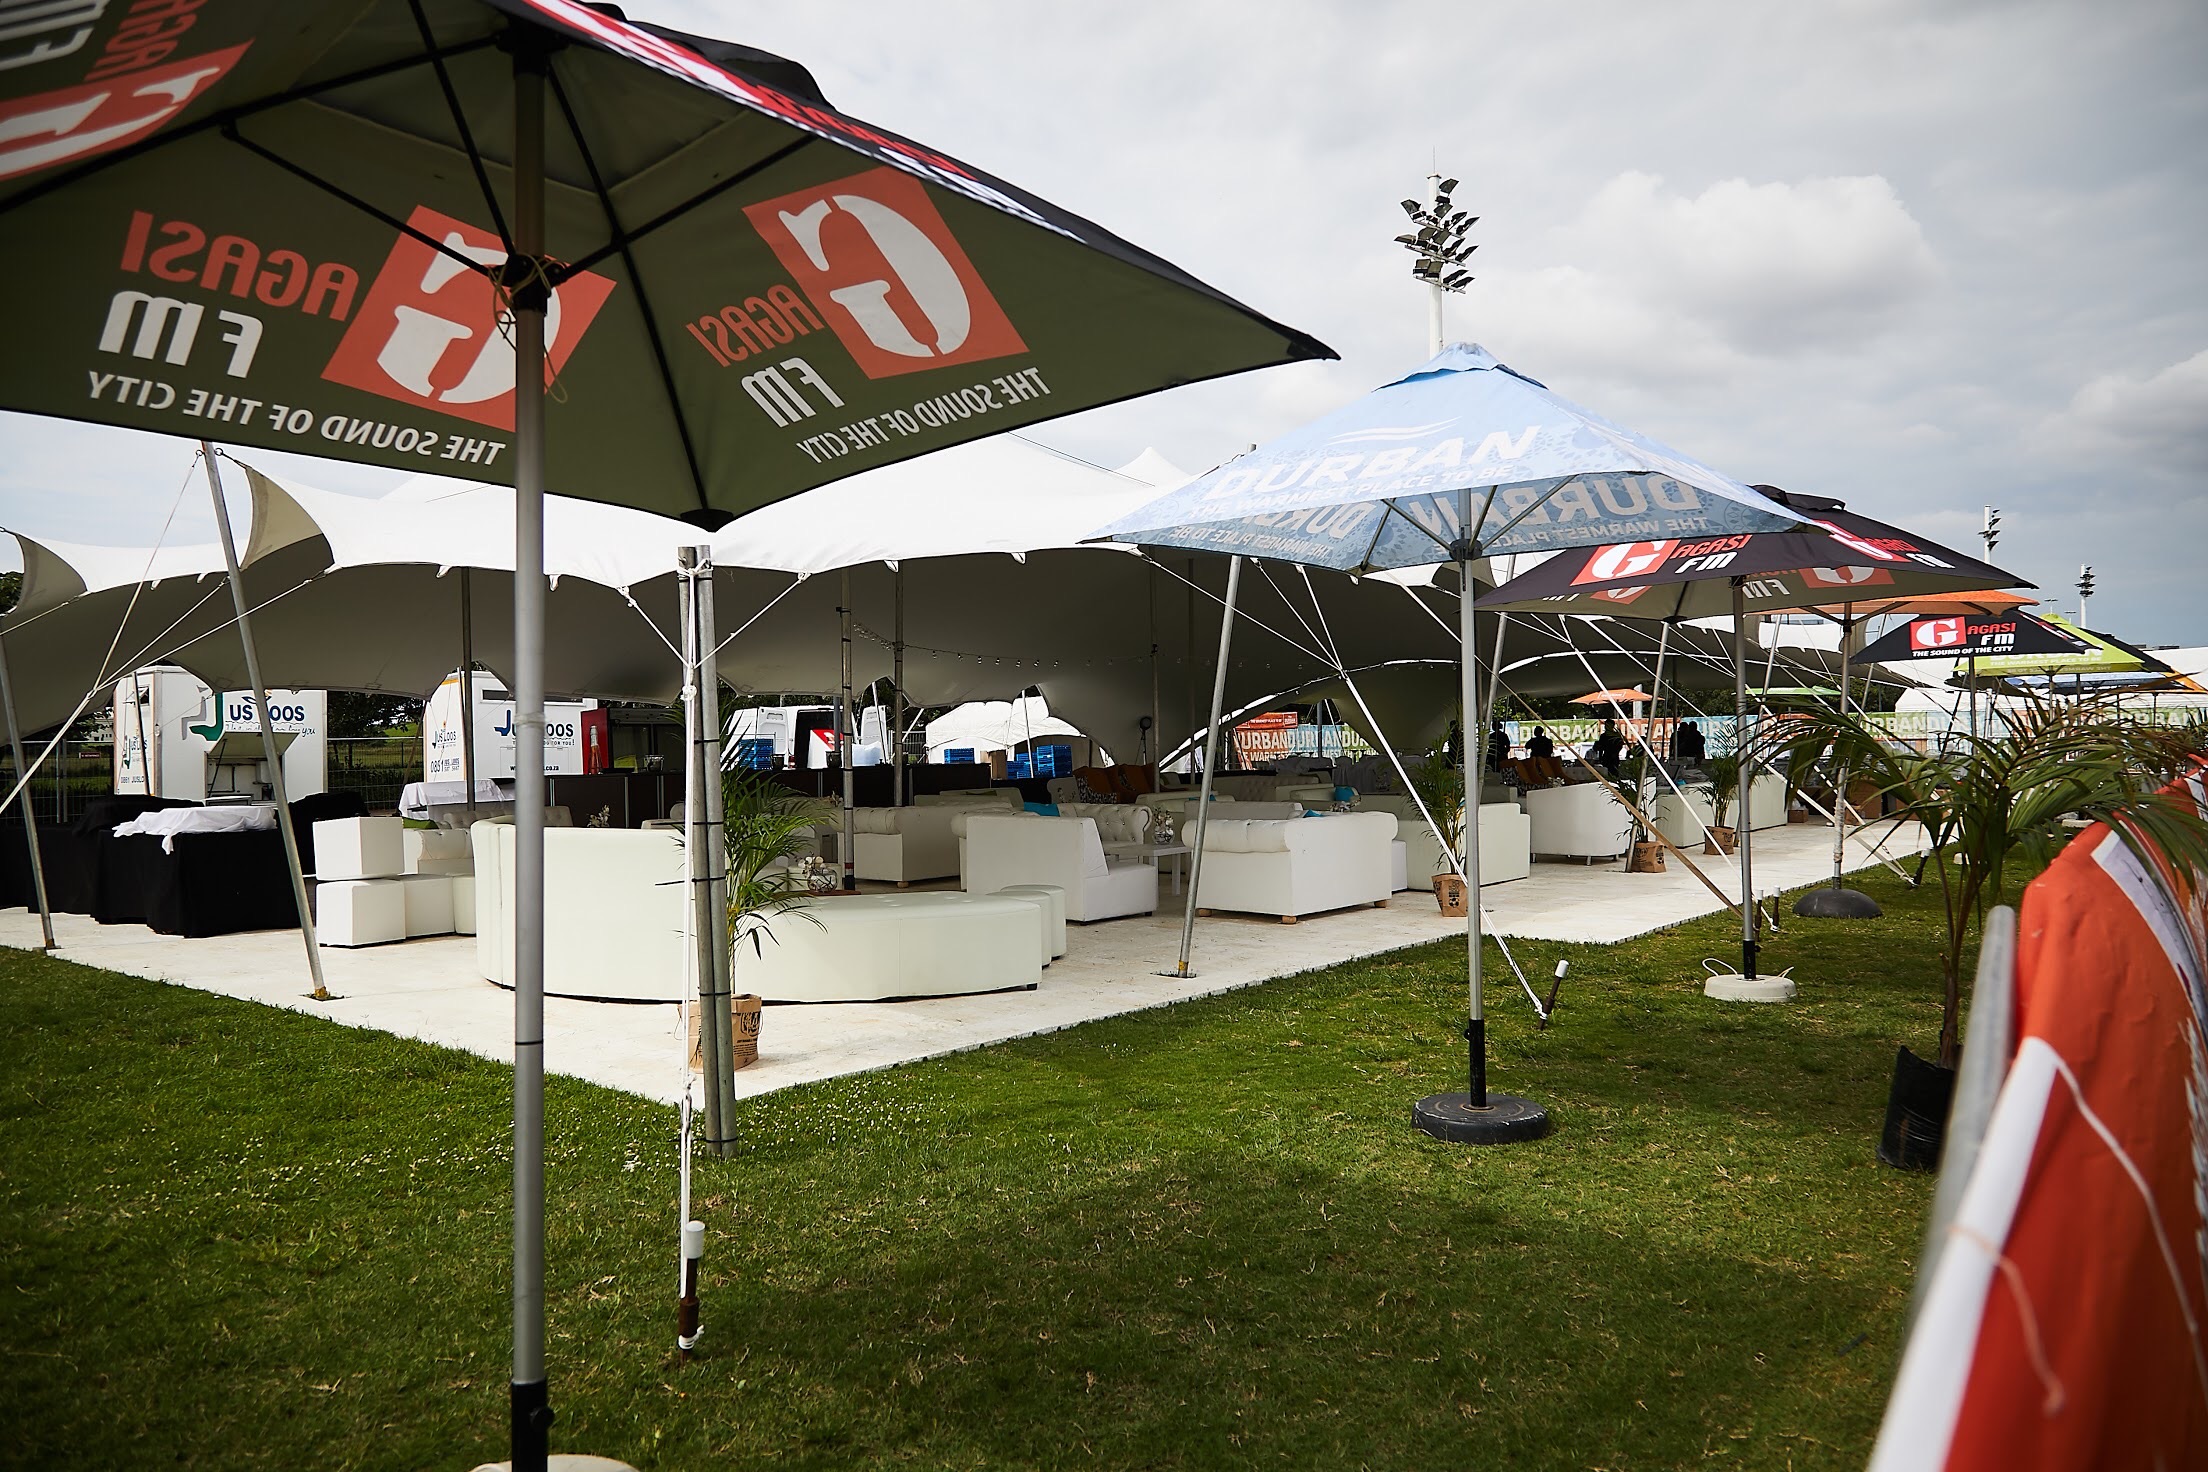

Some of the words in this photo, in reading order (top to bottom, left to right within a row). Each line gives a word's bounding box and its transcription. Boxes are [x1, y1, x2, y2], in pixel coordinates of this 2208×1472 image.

[1203, 425, 1542, 499] DURBAN
[1354, 474, 1433, 498] PLACE
[1443, 469, 1471, 485] TO
[1477, 463, 1515, 481] BE
[1669, 535, 1752, 561] AGASI
[1675, 551, 1738, 574] FM
[1967, 622, 2017, 635] AGASI
[1981, 633, 2015, 647] FM
[1930, 648, 1960, 656] SOUND
[1993, 645, 2014, 653] CITY
[266, 705, 305, 722] OOS
[546, 723, 574, 737] OOS
[1288, 730, 1341, 748] DURAN
